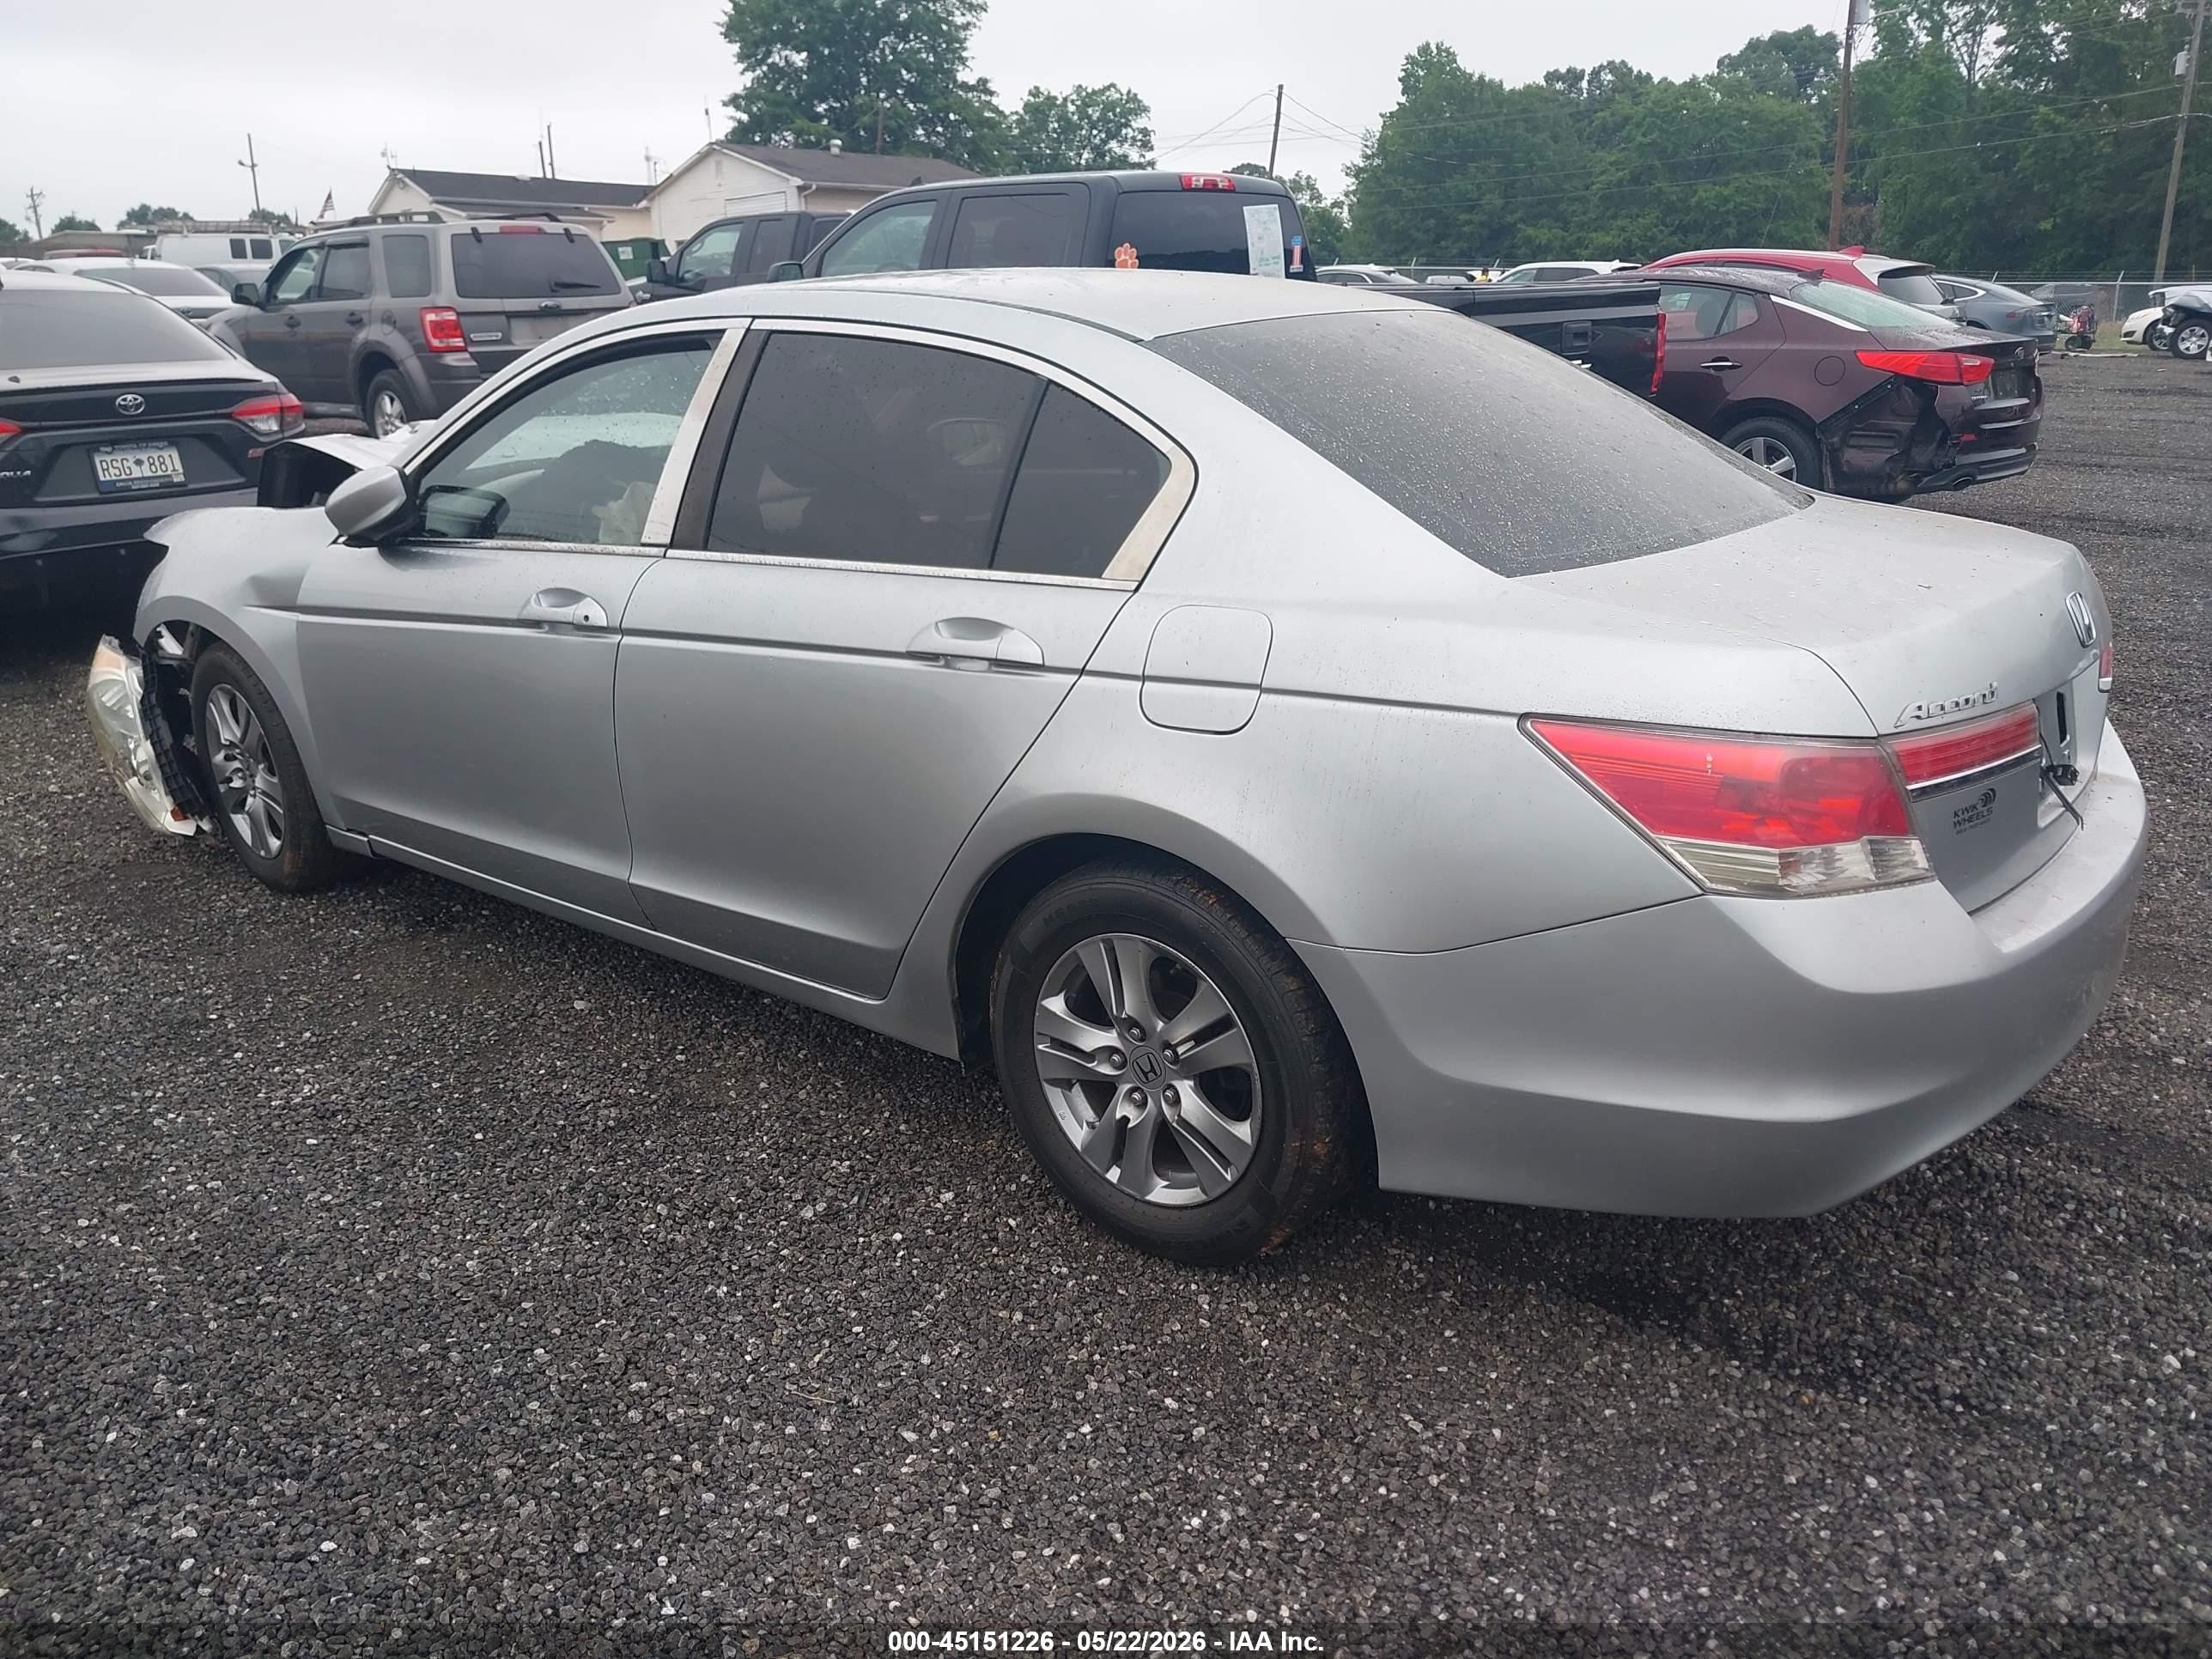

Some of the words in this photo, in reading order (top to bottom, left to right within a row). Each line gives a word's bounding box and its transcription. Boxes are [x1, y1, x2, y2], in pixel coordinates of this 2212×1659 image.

[100, 458, 133, 479] RSG
[148, 454, 179, 474] 881
[1893, 682, 1998, 728] Accord
[1953, 806, 1993, 829] WHEELS
[1954, 803, 1978, 818] KWIK
